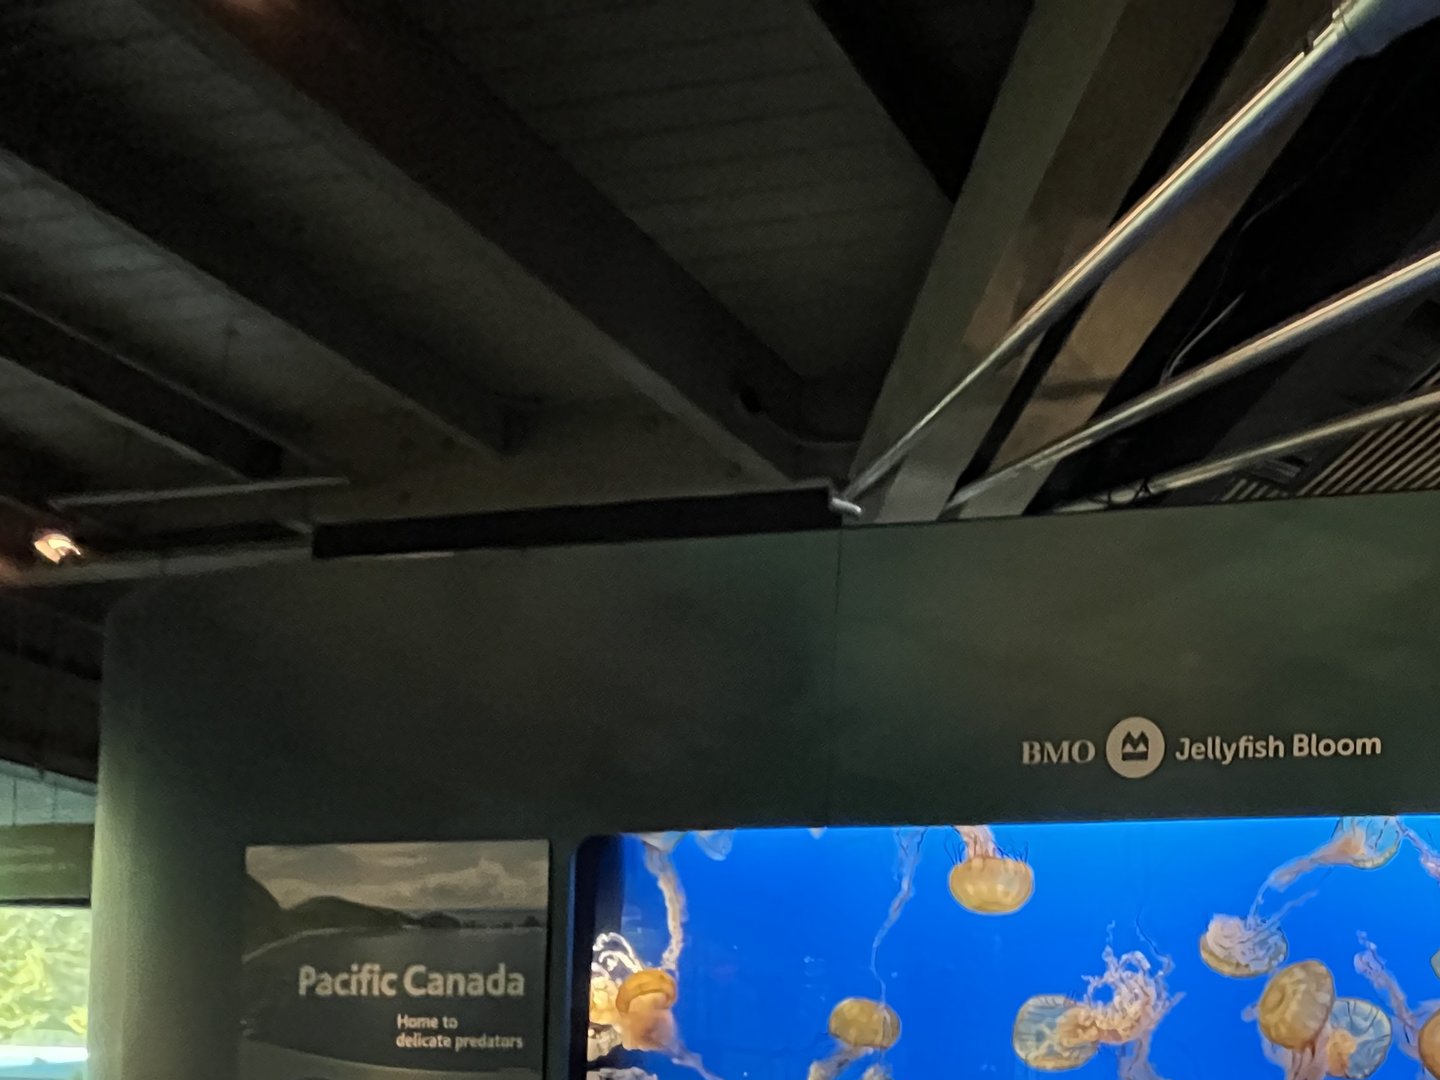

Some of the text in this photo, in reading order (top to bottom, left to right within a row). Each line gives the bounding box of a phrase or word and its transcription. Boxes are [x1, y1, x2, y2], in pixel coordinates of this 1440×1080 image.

[1020, 733, 1382, 765] BMO Jellyfish Bloom
[298, 962, 525, 997] Pacific Canada
[396, 1013, 459, 1030] Home to
[395, 1032, 523, 1053] delicate predators
